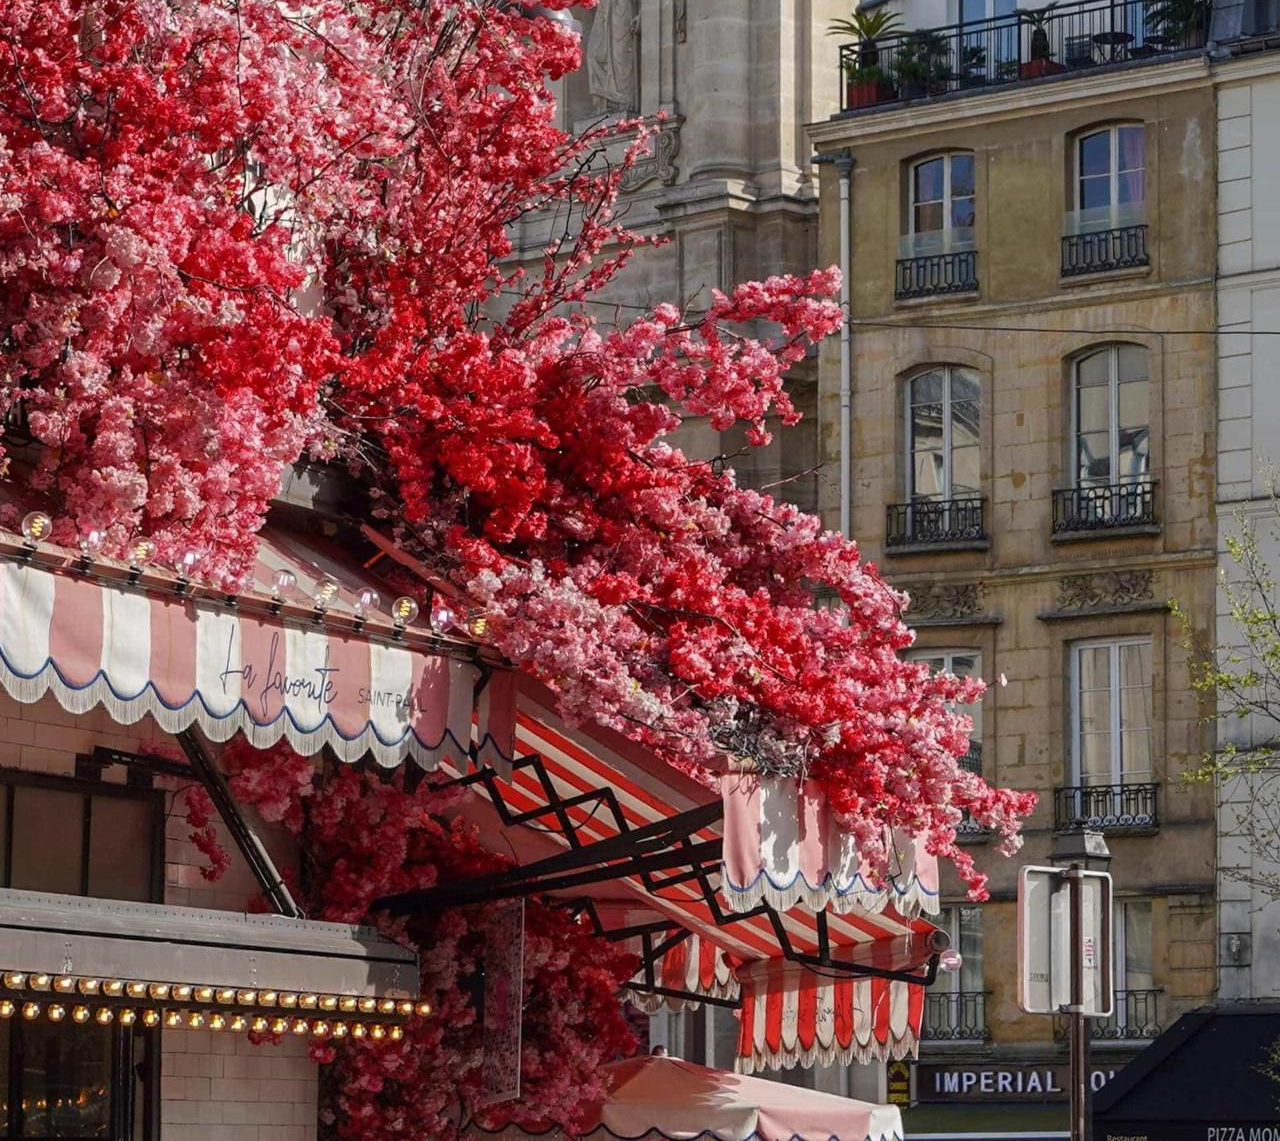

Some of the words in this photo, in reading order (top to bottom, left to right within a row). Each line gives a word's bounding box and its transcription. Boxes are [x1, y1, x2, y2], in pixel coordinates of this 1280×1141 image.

[219, 623, 258, 695] La
[260, 631, 340, 718] favorite
[935, 1070, 1062, 1093] IMPERIAL
[1207, 1127, 1246, 1141] PIZZA
